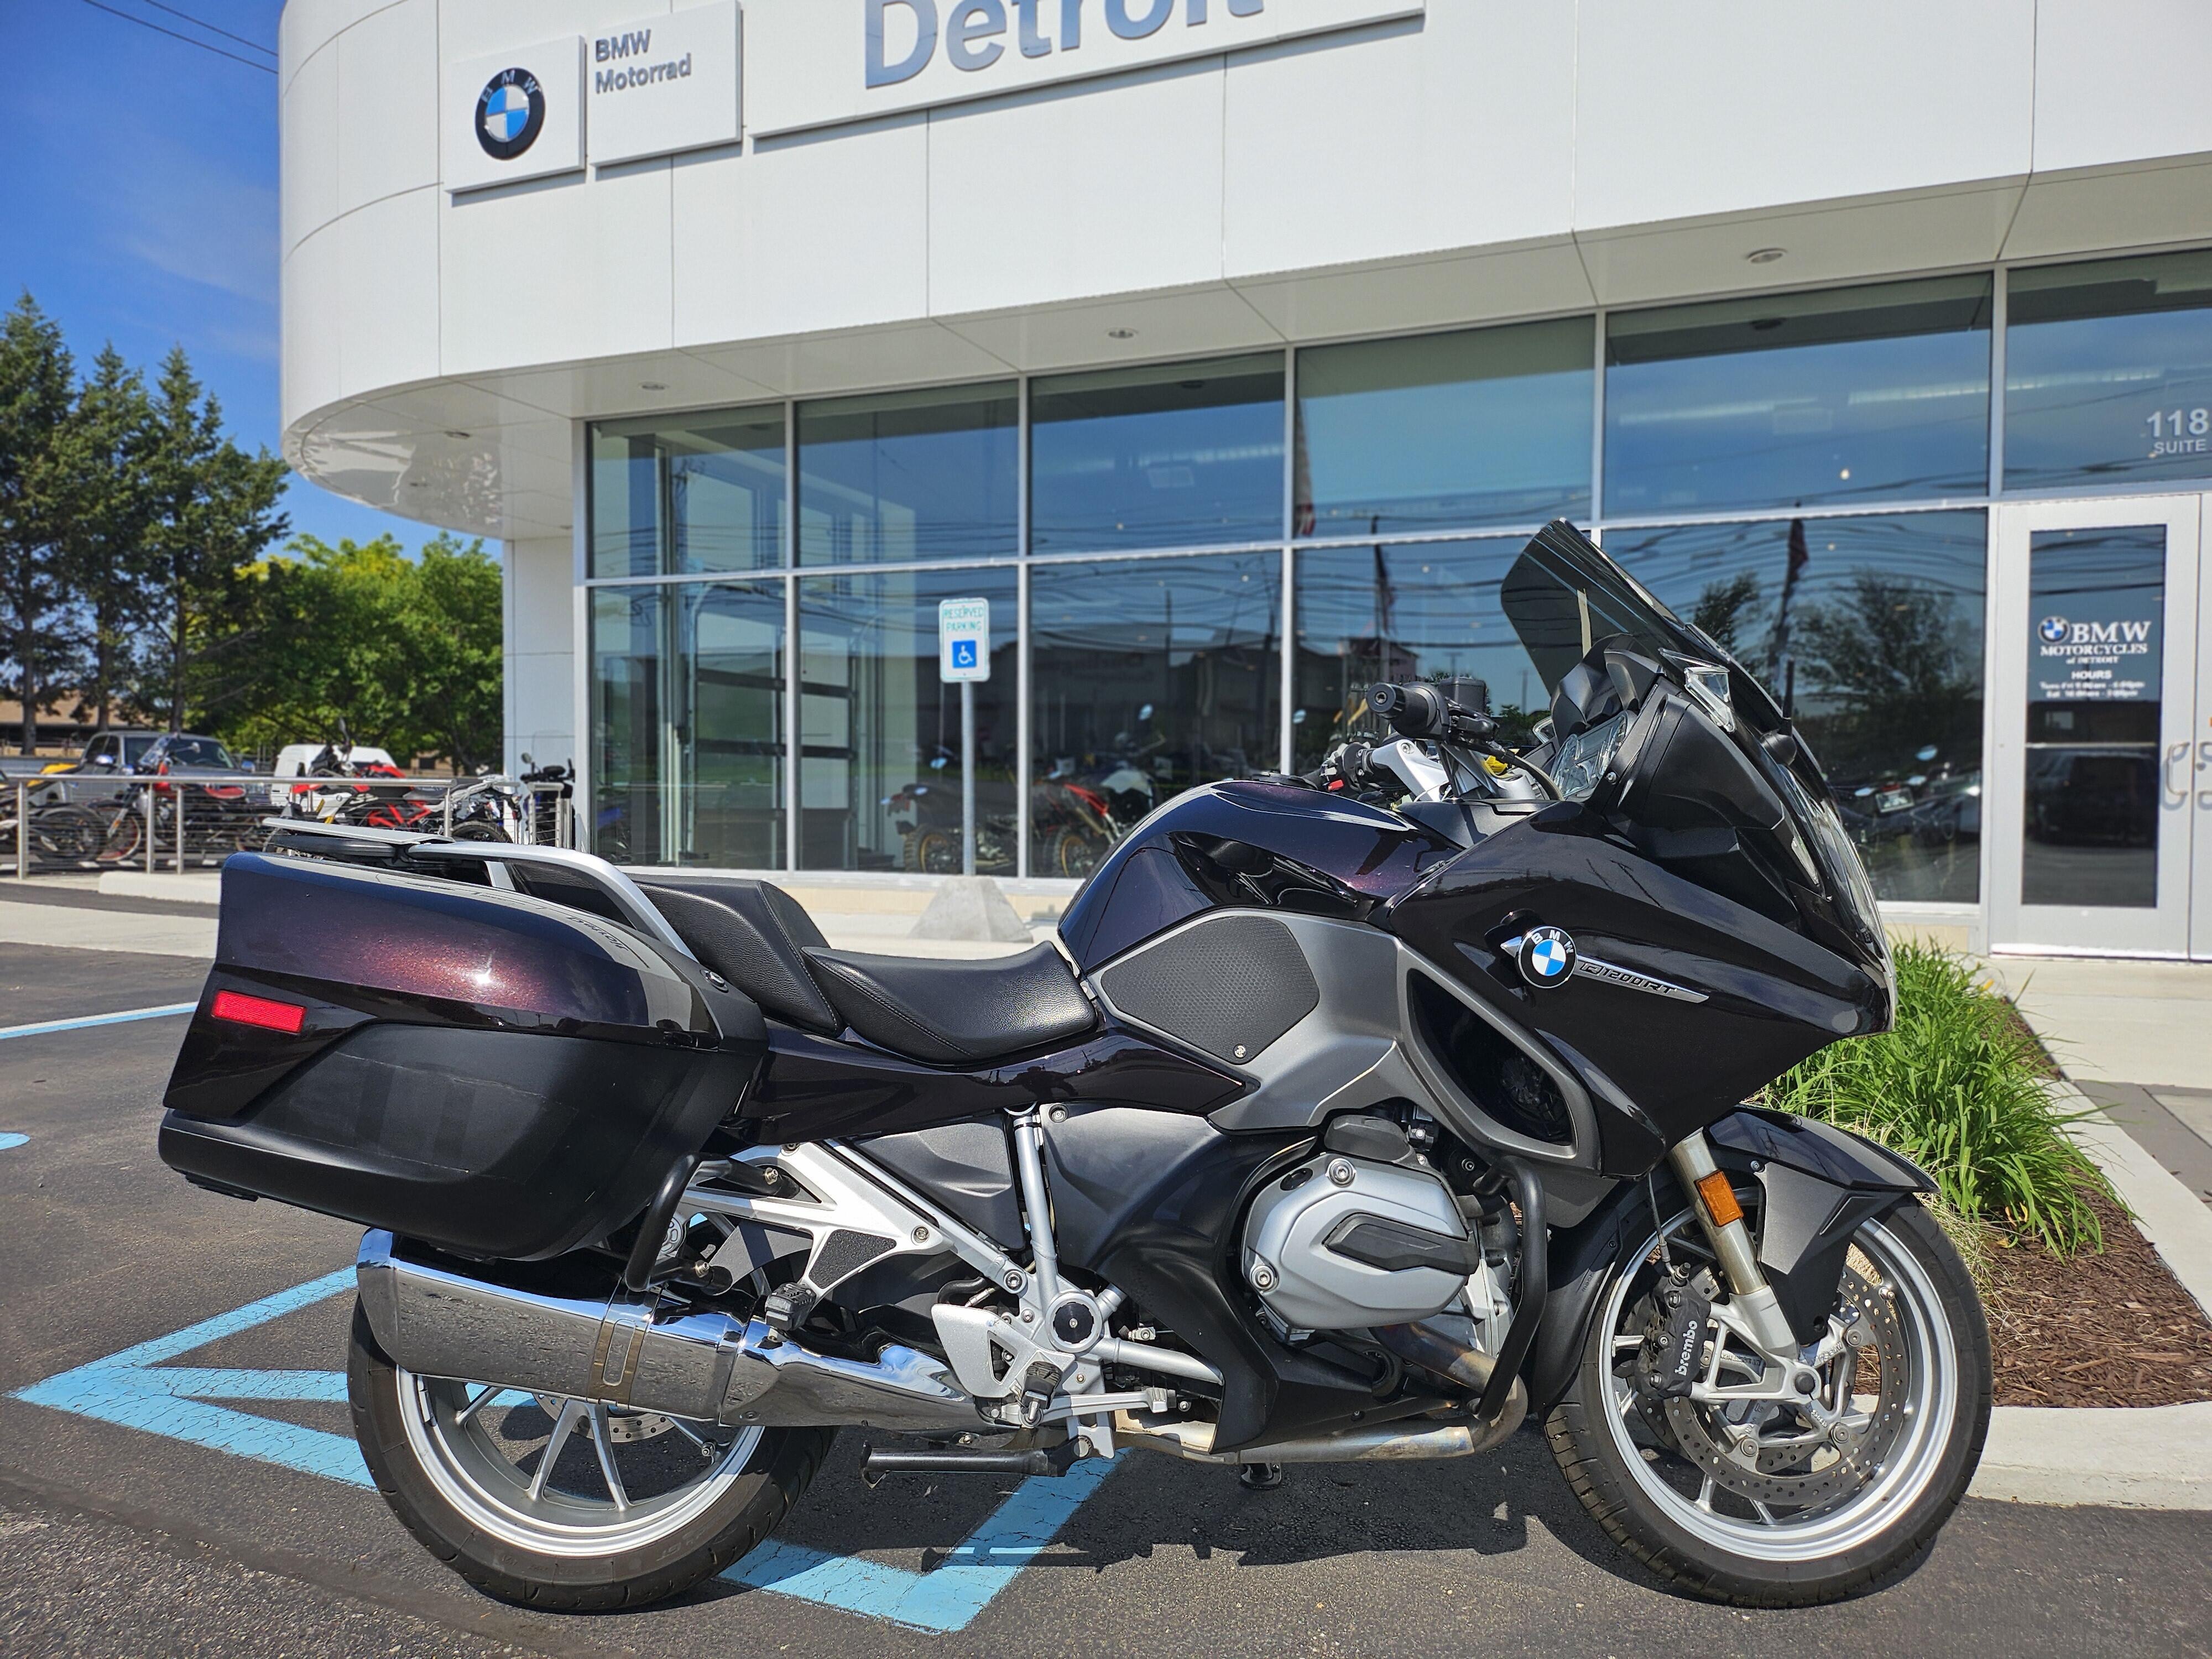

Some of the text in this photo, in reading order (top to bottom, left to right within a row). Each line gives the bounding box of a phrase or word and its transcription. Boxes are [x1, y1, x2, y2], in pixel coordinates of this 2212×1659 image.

[596, 29, 651, 62] BMW
[865, 0, 1264, 89] Detro
[481, 70, 538, 102] BMW
[596, 53, 691, 94] Motorrad
[2147, 409, 2209, 437] 118
[2154, 439, 2207, 454] SUITE
[943, 607, 983, 619] RESERVED
[946, 621, 982, 632] PARKING
[2071, 620, 2151, 644] BMW
[2040, 643, 2148, 656] MOTORCYCLES
[2071, 670, 2112, 680] HOURS
[1531, 929, 1574, 954] BMW
[1674, 1320, 1698, 1376] brembo
